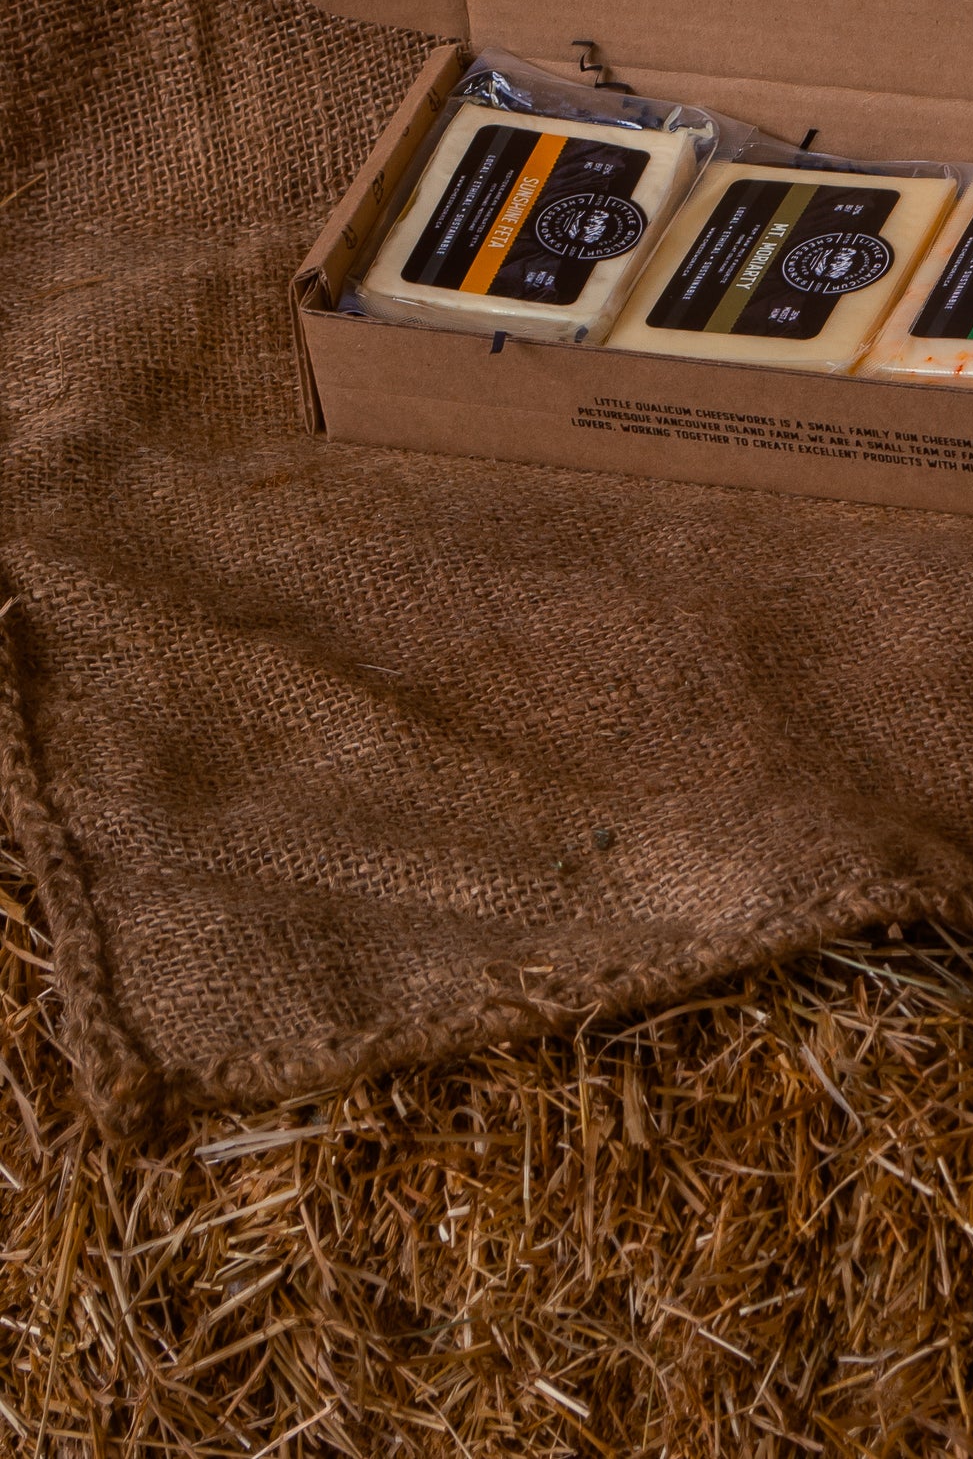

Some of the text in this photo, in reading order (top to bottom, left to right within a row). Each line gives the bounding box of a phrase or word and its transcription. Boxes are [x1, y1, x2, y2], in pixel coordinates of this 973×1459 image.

[478, 154, 495, 173] LOCAL
[461, 180, 482, 206] ETHICAL
[486, 175, 540, 249] SUNSHINE FETA
[728, 206, 746, 223] LOCAL
[435, 213, 464, 254] SUSTAINABLE
[540, 198, 584, 248] CHEESEWORKS
[586, 201, 635, 256] LITTLE QUALICUM
[710, 231, 731, 253] ETHICAL
[733, 223, 789, 289] MT. MORIARTY
[786, 237, 833, 285] CHEESEWORKS
[831, 238, 883, 290] LITTLE QUALICUM
[681, 261, 712, 300] SUSTAINABLE
[943, 270, 973, 309] SUSTAINABLE
[578, 407, 651, 423] PICTURESQUE
[655, 416, 720, 431] VANCOUVER
[724, 424, 764, 436] ISLAND
[807, 433, 824, 443] WE
[829, 436, 850, 446] ARE
[855, 439, 861, 447] A
[867, 440, 904, 452] SMALL
[909, 445, 939, 456] TEAM
[943, 449, 956, 458] OF
[593, 397, 631, 409] LITTLE
[635, 401, 691, 416] QUALICUM
[695, 408, 775, 426] CHEESEWORKS
[779, 418, 790, 427] IS
[796, 420, 802, 429] A
[808, 421, 844, 434] SMALL
[849, 426, 889, 439] FAMILY
[895, 431, 917, 442] RUN
[620, 423, 670, 437] WORKING
[674, 429, 730, 444] TOGETHER
[733, 436, 748, 446] TO
[753, 439, 794, 452] CREATE
[798, 444, 857, 459] EXCELLENT
[863, 451, 922, 466] PRODUCTS
[927, 459, 957, 470] WITH
